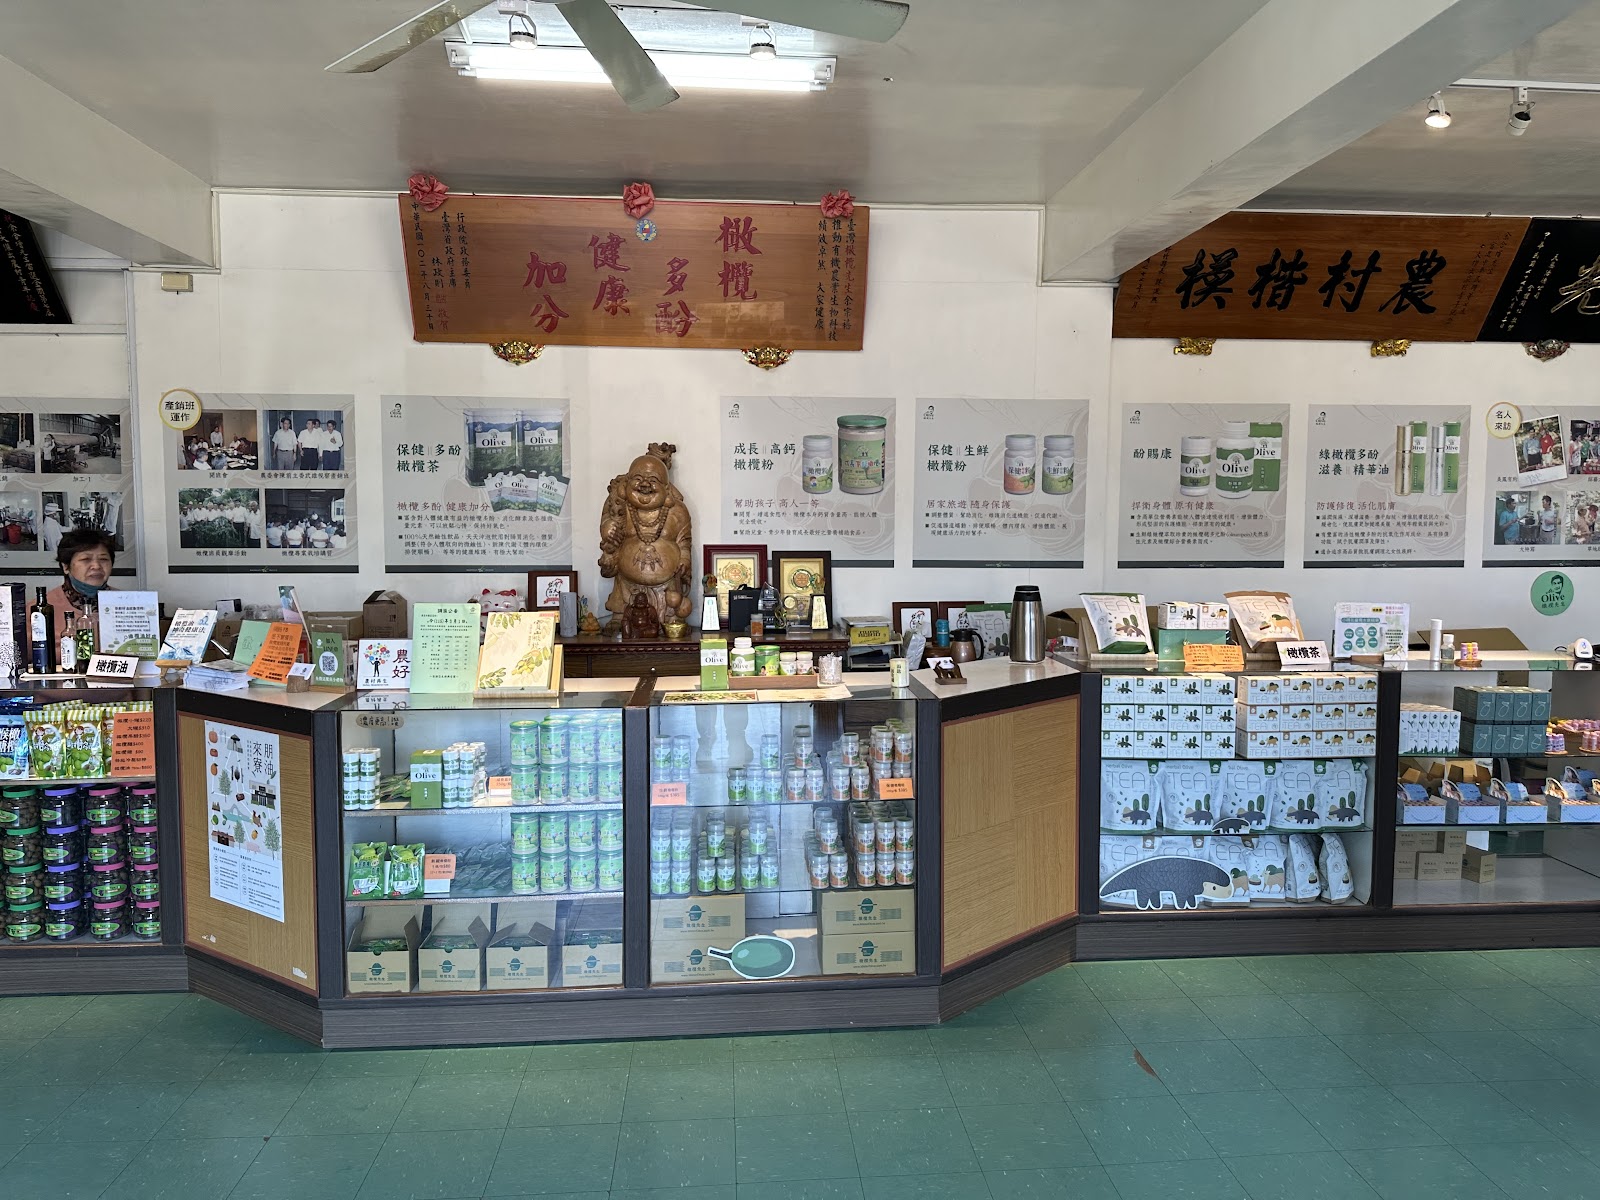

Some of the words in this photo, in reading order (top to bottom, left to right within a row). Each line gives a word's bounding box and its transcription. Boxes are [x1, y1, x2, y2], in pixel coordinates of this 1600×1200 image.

[441, 211, 457, 289] 臺灣省政府主席
[456, 211, 472, 290] 行政院政務委員
[714, 215, 763, 301] 橄欖
[587, 231, 631, 317] 健康
[828, 218, 842, 342] 推動有機農業生物科技
[522, 251, 570, 334] 加分
[654, 256, 701, 338] 多酚
[814, 281, 826, 330] 大家健康
[164, 400, 195, 411] 產銷班
[170, 412, 190, 422] 運作
[1495, 410, 1512, 420] 名人
[1494, 421, 1512, 431] 來訪
[481, 437, 506, 447] Olive
[529, 436, 553, 445] Olive
[396, 443, 425, 456] 保健
[434, 443, 461, 457] 多酚
[733, 443, 759, 455] 成長
[770, 443, 796, 455] 高鈣
[927, 444, 953, 457] 保健
[964, 444, 989, 457] 生鮮
[1133, 448, 1172, 460] 酚賜康
[1318, 448, 1379, 461] 綠橄欖多酚
[396, 460, 440, 473] 橄欖茶
[733, 459, 774, 472] 橄欖粉
[926, 460, 967, 473] 橄欖粉
[1185, 466, 1207, 474] Olive
[1221, 463, 1250, 473] Olive
[1318, 464, 1343, 475] 滋養
[1353, 464, 1389, 476] 精華油
[511, 481, 529, 489] Olive
[541, 483, 558, 492] Olive
[396, 501, 442, 512] 橄欖多酚
[446, 501, 491, 512] 健康加分
[734, 499, 775, 508] 幫助孩子
[779, 499, 820, 508] 高人一等
[926, 500, 967, 509] 居家旅遊
[969, 500, 1011, 509] 隨身保護
[1131, 501, 1171, 511] 捍衛身體
[1174, 501, 1215, 511] 原有健康
[1316, 501, 1355, 511] 防護修復
[1358, 501, 1397, 511] 活化肌膚
[1541, 593, 1565, 603] Olive
[1240, 601, 1280, 613] TEA
[975, 618, 1005, 631] TEA
[1285, 646, 1321, 660] 橄欖茶
[95, 659, 129, 674] 橄欖油
[1105, 771, 1146, 789] TEA
[1167, 771, 1208, 790] TEA
[1099, 843, 1139, 862] TEA
